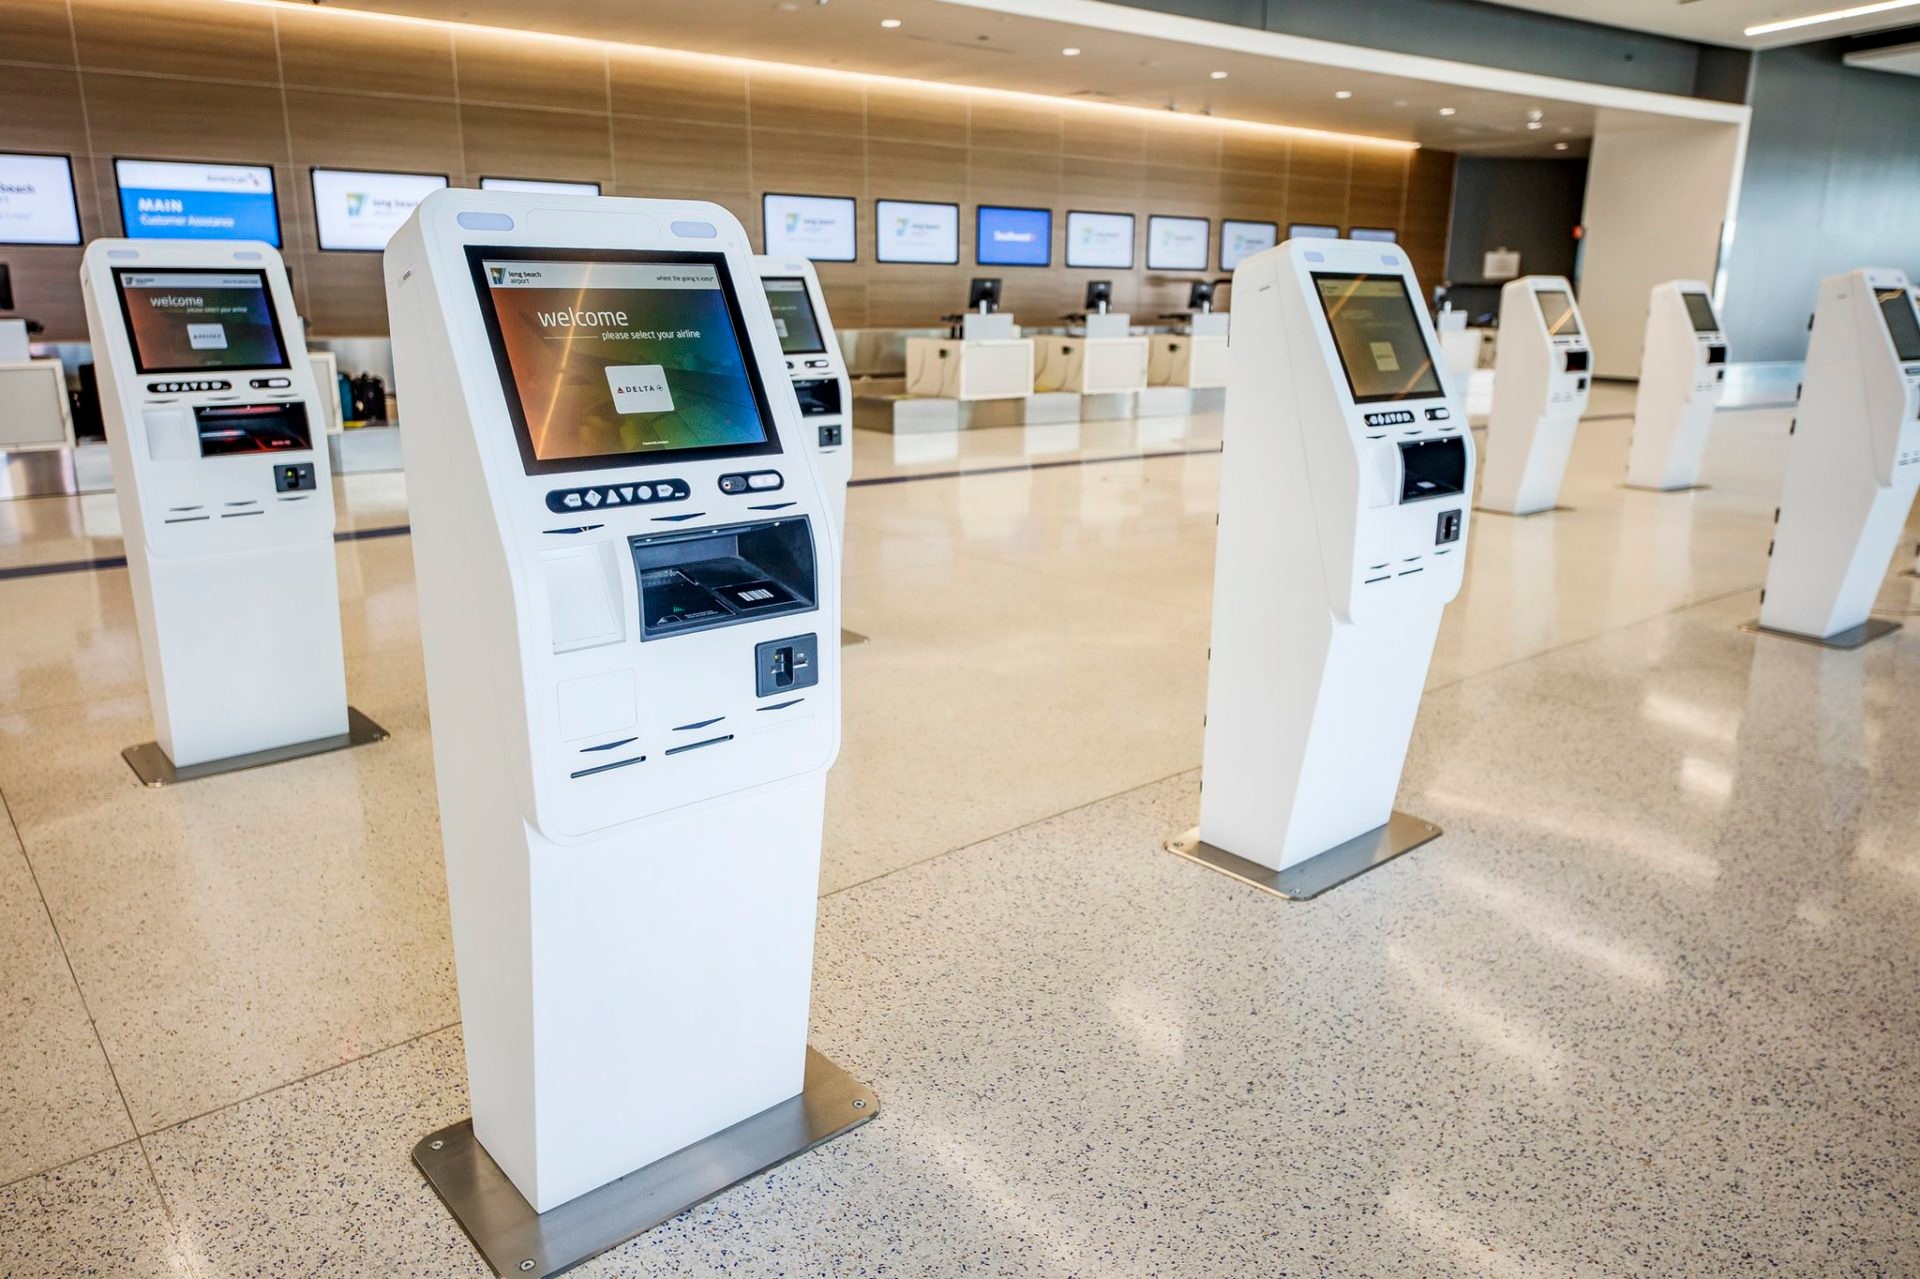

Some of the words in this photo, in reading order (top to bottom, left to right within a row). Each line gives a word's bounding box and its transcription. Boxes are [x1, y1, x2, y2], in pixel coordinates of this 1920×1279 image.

[137, 197, 183, 213] MAIN
[139, 213, 186, 227] Customer
[187, 214, 235, 228] Assistance
[508, 270, 523, 279] long
[150, 294, 204, 308] welcome
[537, 306, 629, 327] welcome
[601, 331, 630, 341] please
[631, 330, 655, 340] select
[657, 331, 674, 341] your
[676, 329, 701, 339] airline
[625, 385, 656, 393] DELTA
